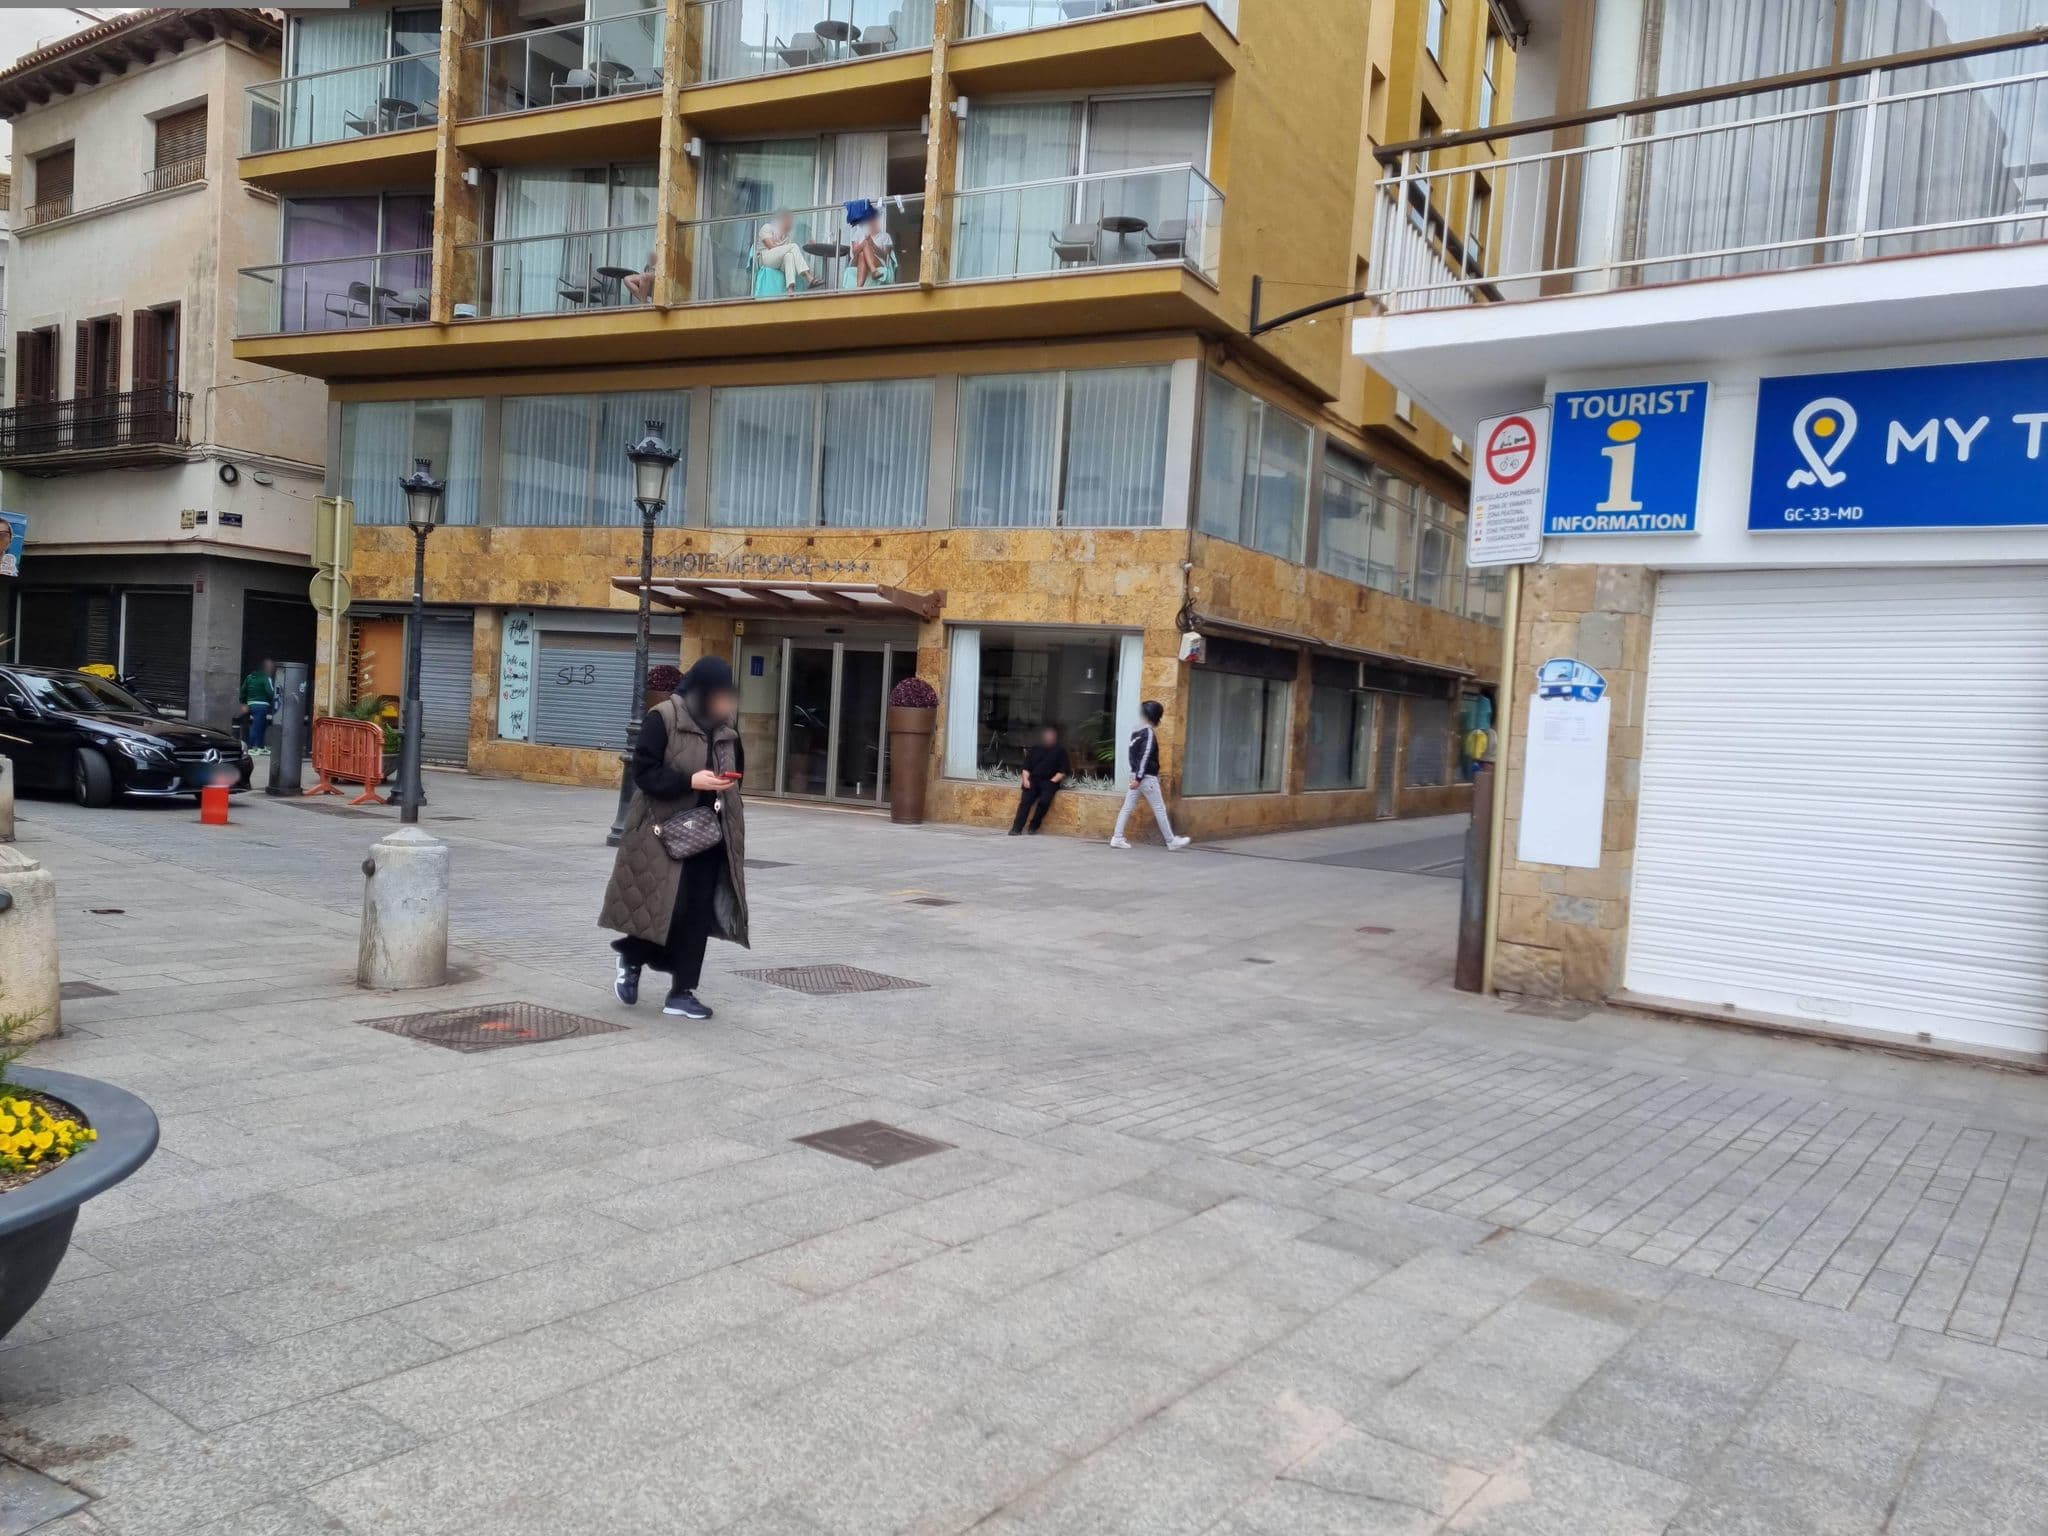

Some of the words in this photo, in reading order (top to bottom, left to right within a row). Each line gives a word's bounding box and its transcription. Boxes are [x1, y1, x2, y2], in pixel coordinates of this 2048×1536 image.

[1567, 389, 1694, 420] TOURIST
[1886, 416, 1990, 465] MY
[1552, 513, 1687, 531] INFORMATION
[1784, 506, 1863, 521] GC-33-MD
[673, 552, 720, 574] HOTEL
[725, 553, 812, 576] METROPOL
[556, 664, 596, 686] SLB
